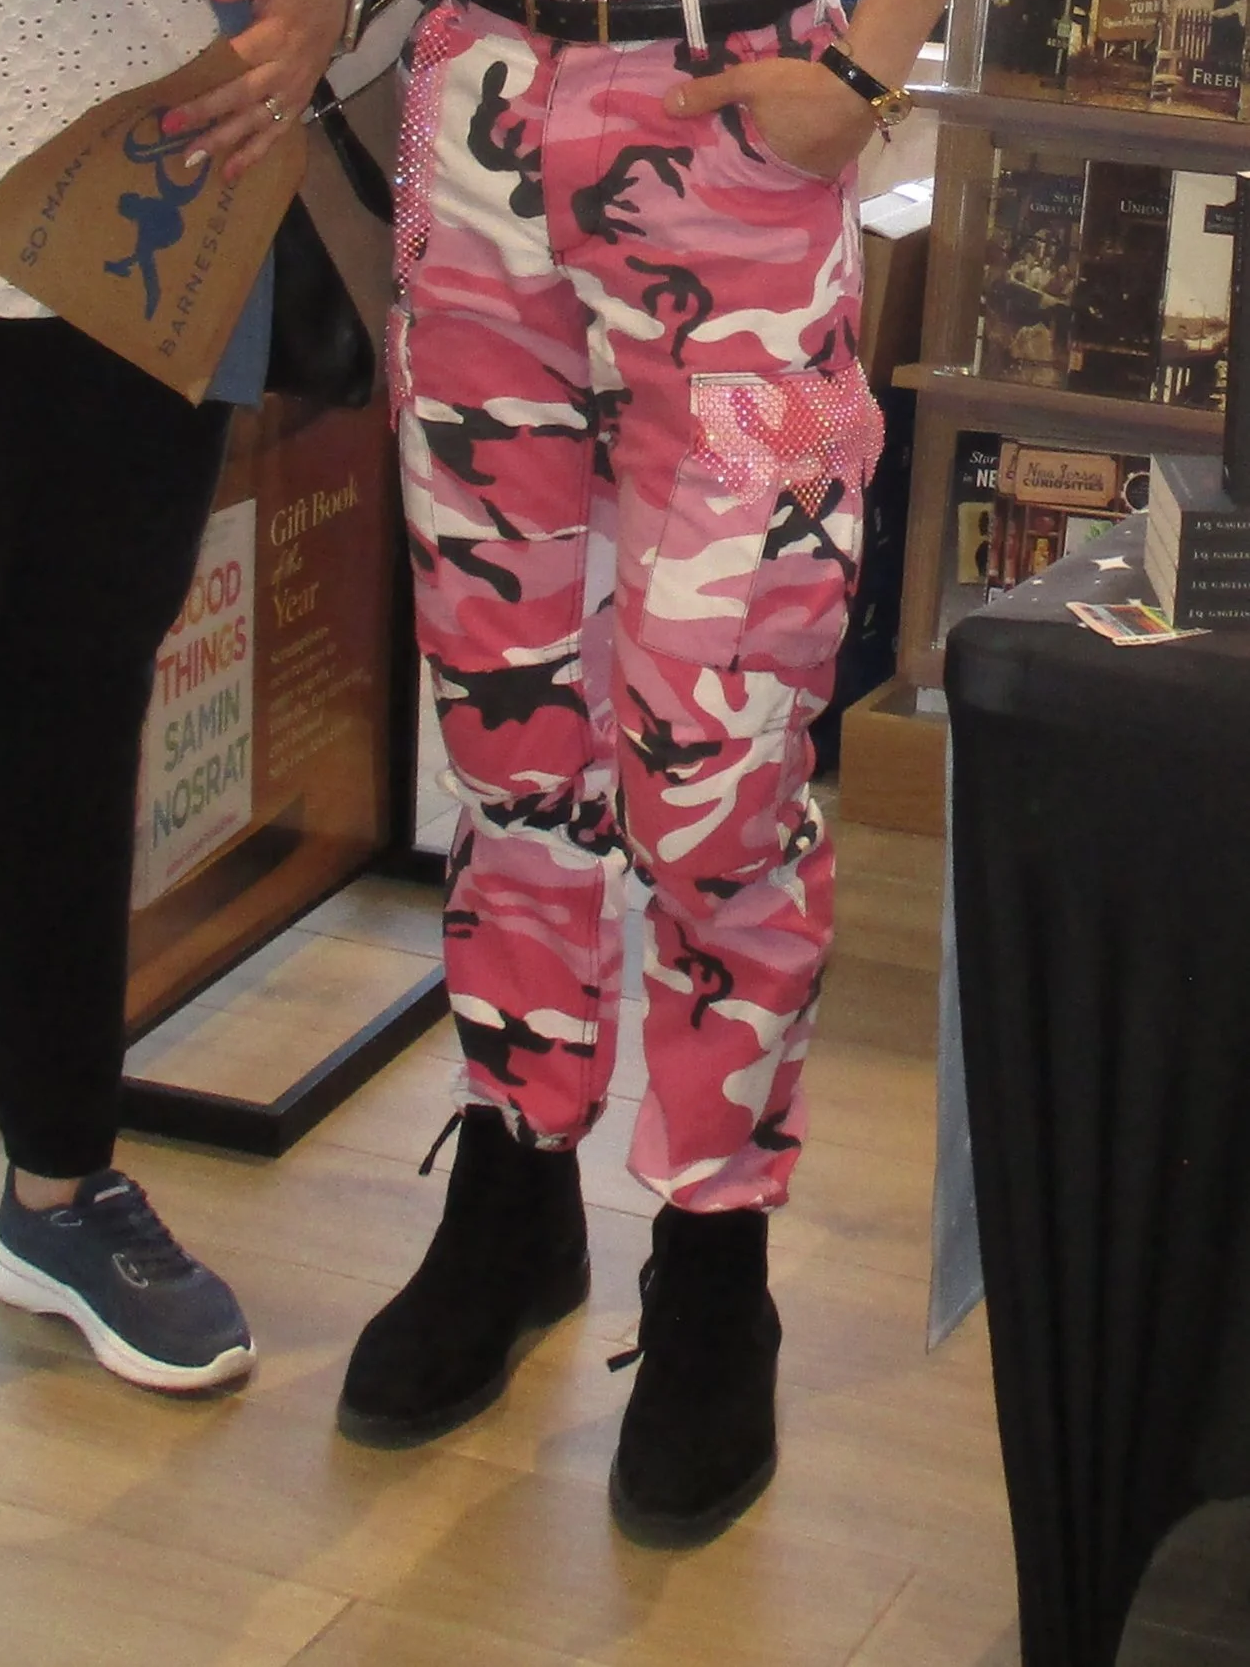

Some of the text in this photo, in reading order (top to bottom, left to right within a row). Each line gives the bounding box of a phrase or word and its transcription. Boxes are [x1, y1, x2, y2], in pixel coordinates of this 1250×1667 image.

[21, 146, 92, 267] SO MANY
[1120, 199, 1165, 214] UNION
[1022, 478, 1104, 492] CURIOSITIES
[1023, 461, 1104, 483] New Jersey
[270, 498, 311, 547] Gift
[312, 473, 359, 527] Book
[270, 581, 320, 630] Year
[157, 616, 246, 706] THINGS
[164, 680, 241, 774] SAMIN
[152, 735, 248, 849] NOSRAT
